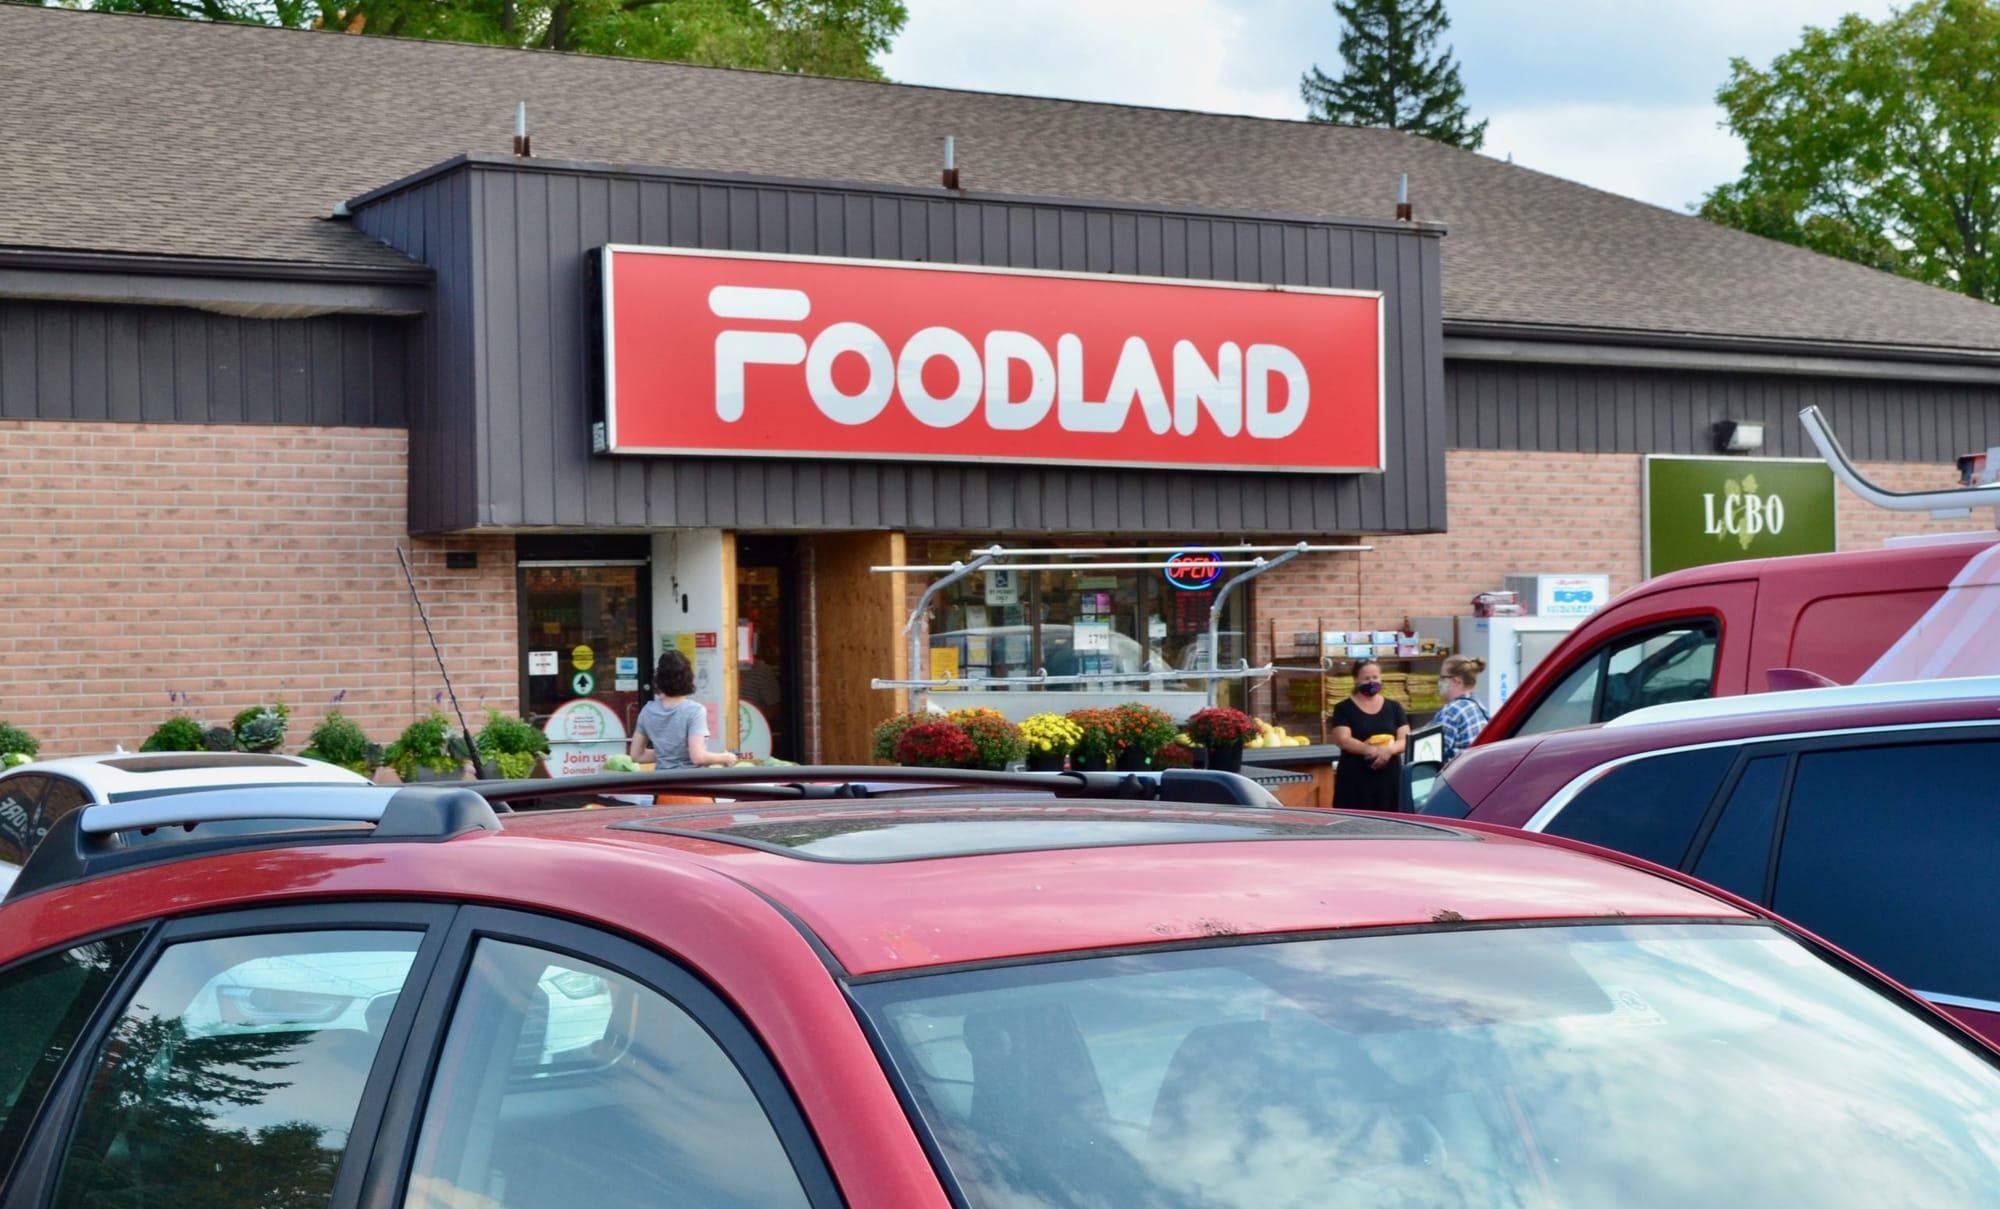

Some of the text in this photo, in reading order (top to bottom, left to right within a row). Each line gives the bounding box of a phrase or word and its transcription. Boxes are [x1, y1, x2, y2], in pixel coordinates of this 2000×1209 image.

[708, 285, 1310, 438] FOODLAND
[1702, 493, 1784, 535] LCBO
[1168, 556, 1217, 579] OPEN
[562, 751, 607, 763] Join us
[562, 766, 596, 775] Donate
